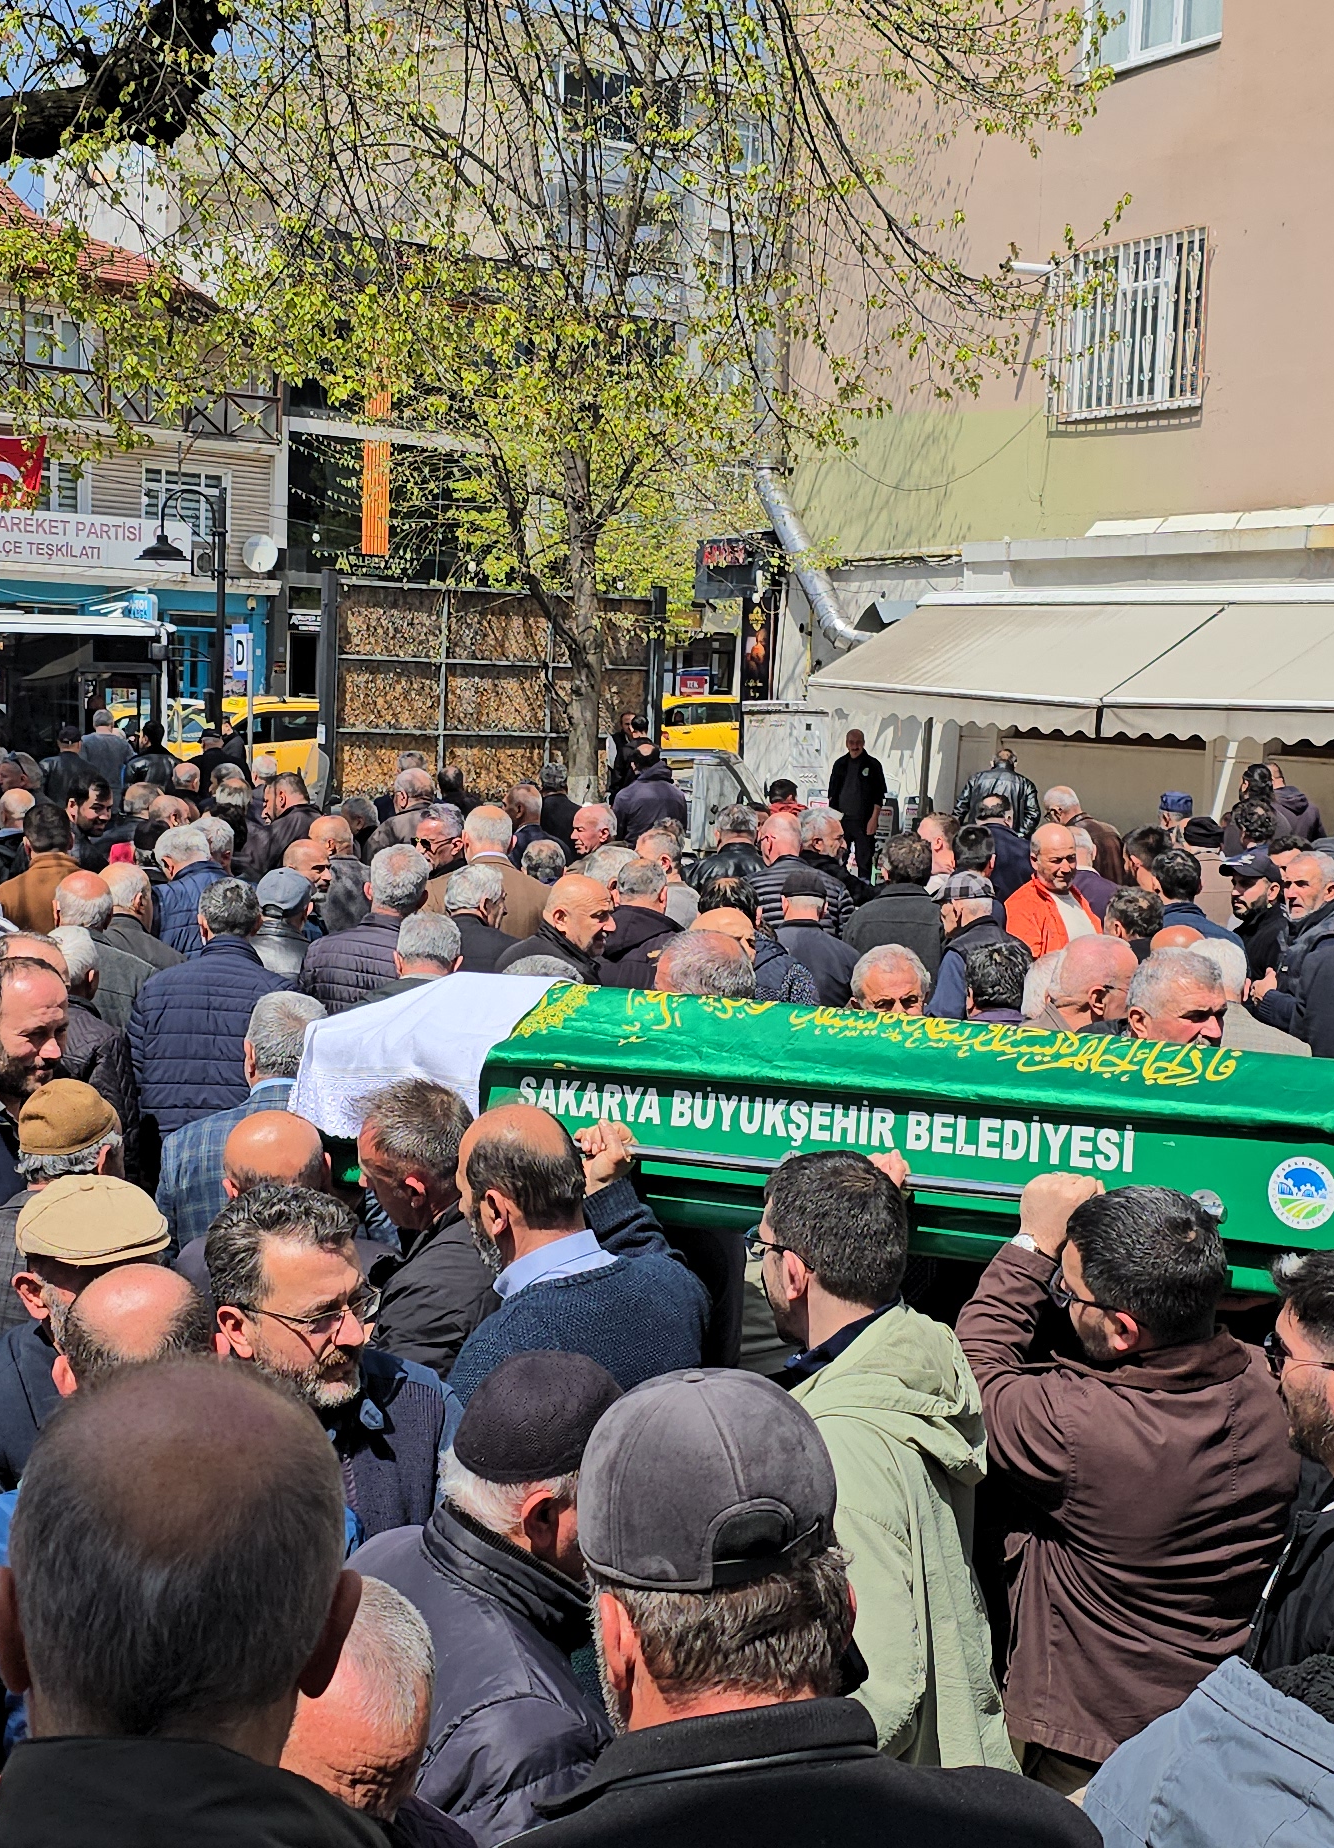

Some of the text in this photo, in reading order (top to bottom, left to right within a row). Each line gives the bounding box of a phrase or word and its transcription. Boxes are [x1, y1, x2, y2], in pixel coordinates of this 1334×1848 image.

[76, 521, 142, 542] PARTİSİ
[27, 541, 101, 560] TEŞKİLATI
[518, 1076, 661, 1126] SAKARYA
[905, 1110, 1135, 1172] BELEDİYESİ
